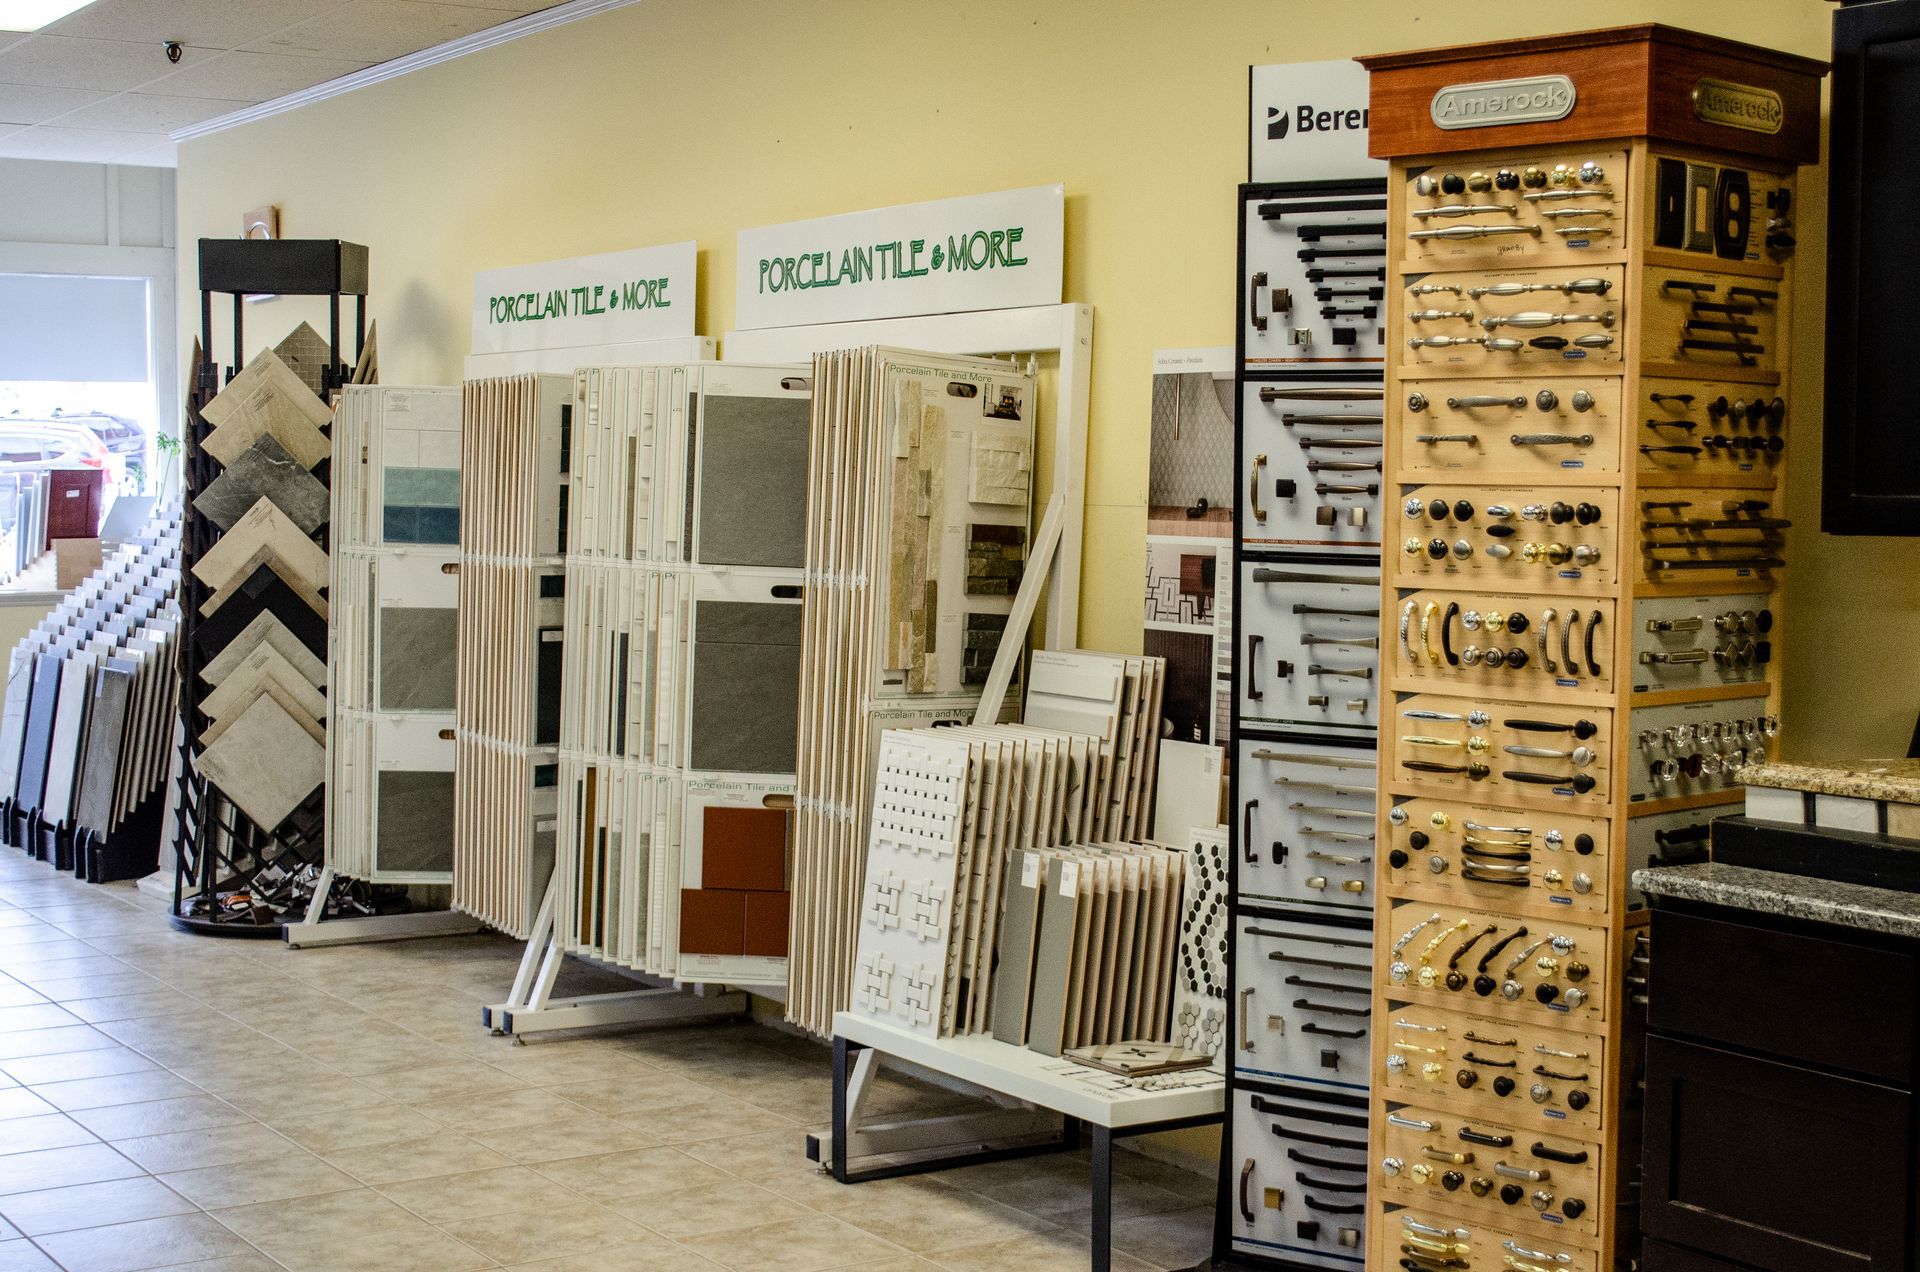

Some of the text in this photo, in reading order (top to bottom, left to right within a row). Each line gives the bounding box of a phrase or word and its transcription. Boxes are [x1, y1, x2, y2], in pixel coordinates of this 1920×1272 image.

[1440, 86, 1564, 118] Amerock
[1297, 105, 1369, 133] Bere
[759, 227, 1028, 294] PORCELAIN TILE & MORE
[489, 278, 671, 324] PORCELAIN TILE & MORE
[890, 364, 992, 383] Porcelain Tile and More
[873, 710, 915, 720] Porcelain
[918, 709, 933, 719] Tile
[935, 709, 951, 718] and
[688, 780, 742, 791] Porcelain
[747, 782, 765, 791] Tile
[769, 784, 790, 792] and
